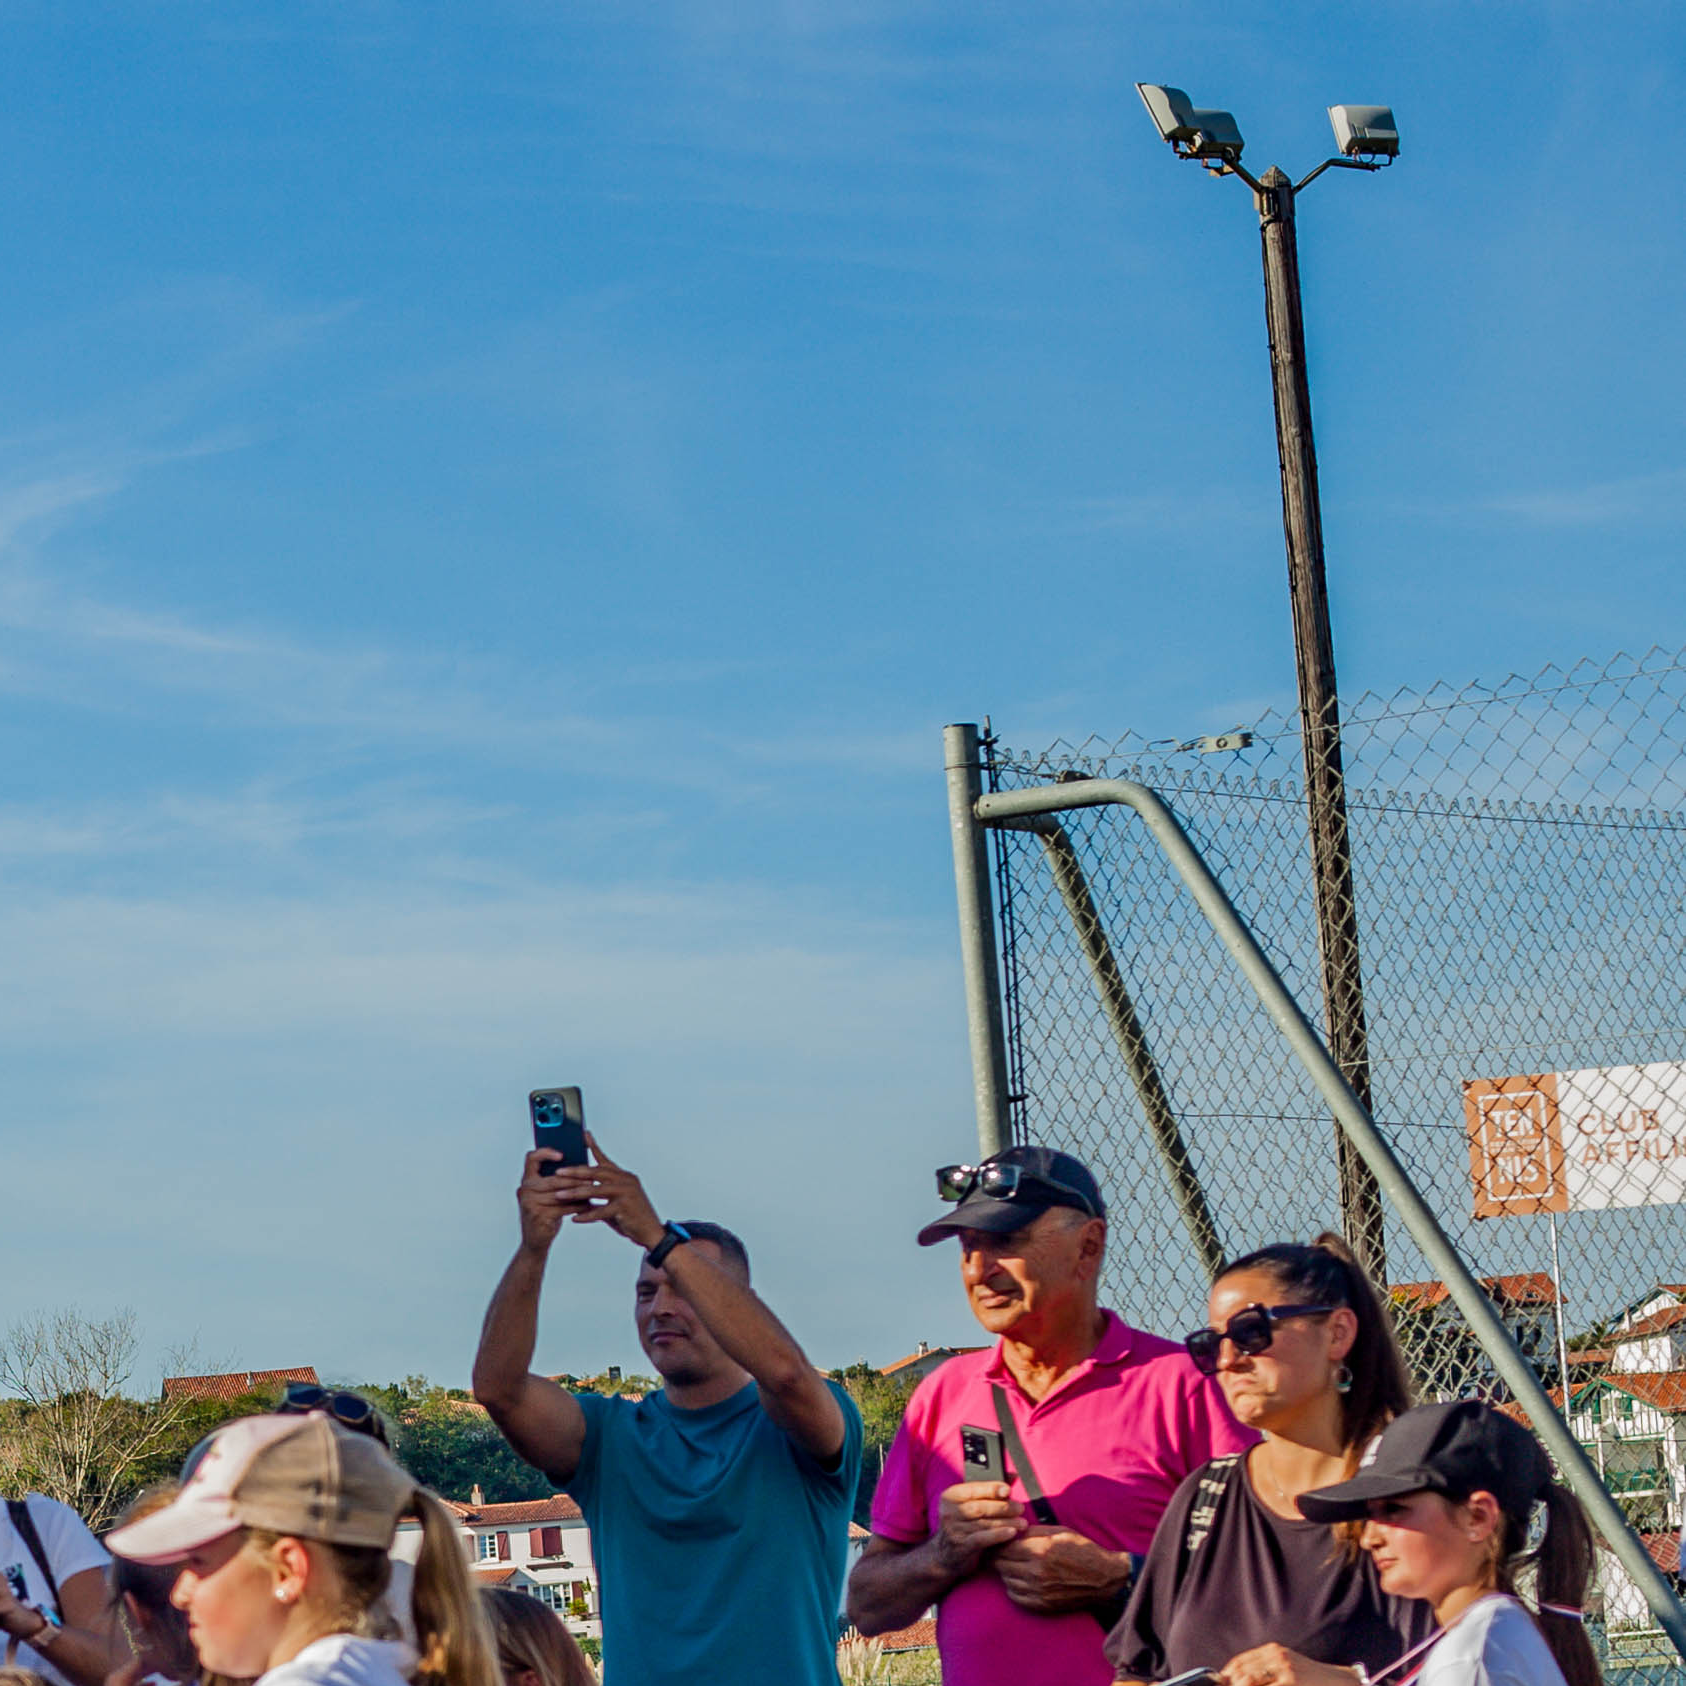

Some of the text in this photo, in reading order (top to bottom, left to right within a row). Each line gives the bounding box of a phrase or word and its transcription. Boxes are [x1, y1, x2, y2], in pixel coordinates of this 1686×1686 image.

[1489, 1108, 1534, 1138] TEN
[1577, 1108, 1660, 1136] CLUB
[1581, 1135, 1686, 1166] AFFILI
[1496, 1153, 1539, 1184] NIS
